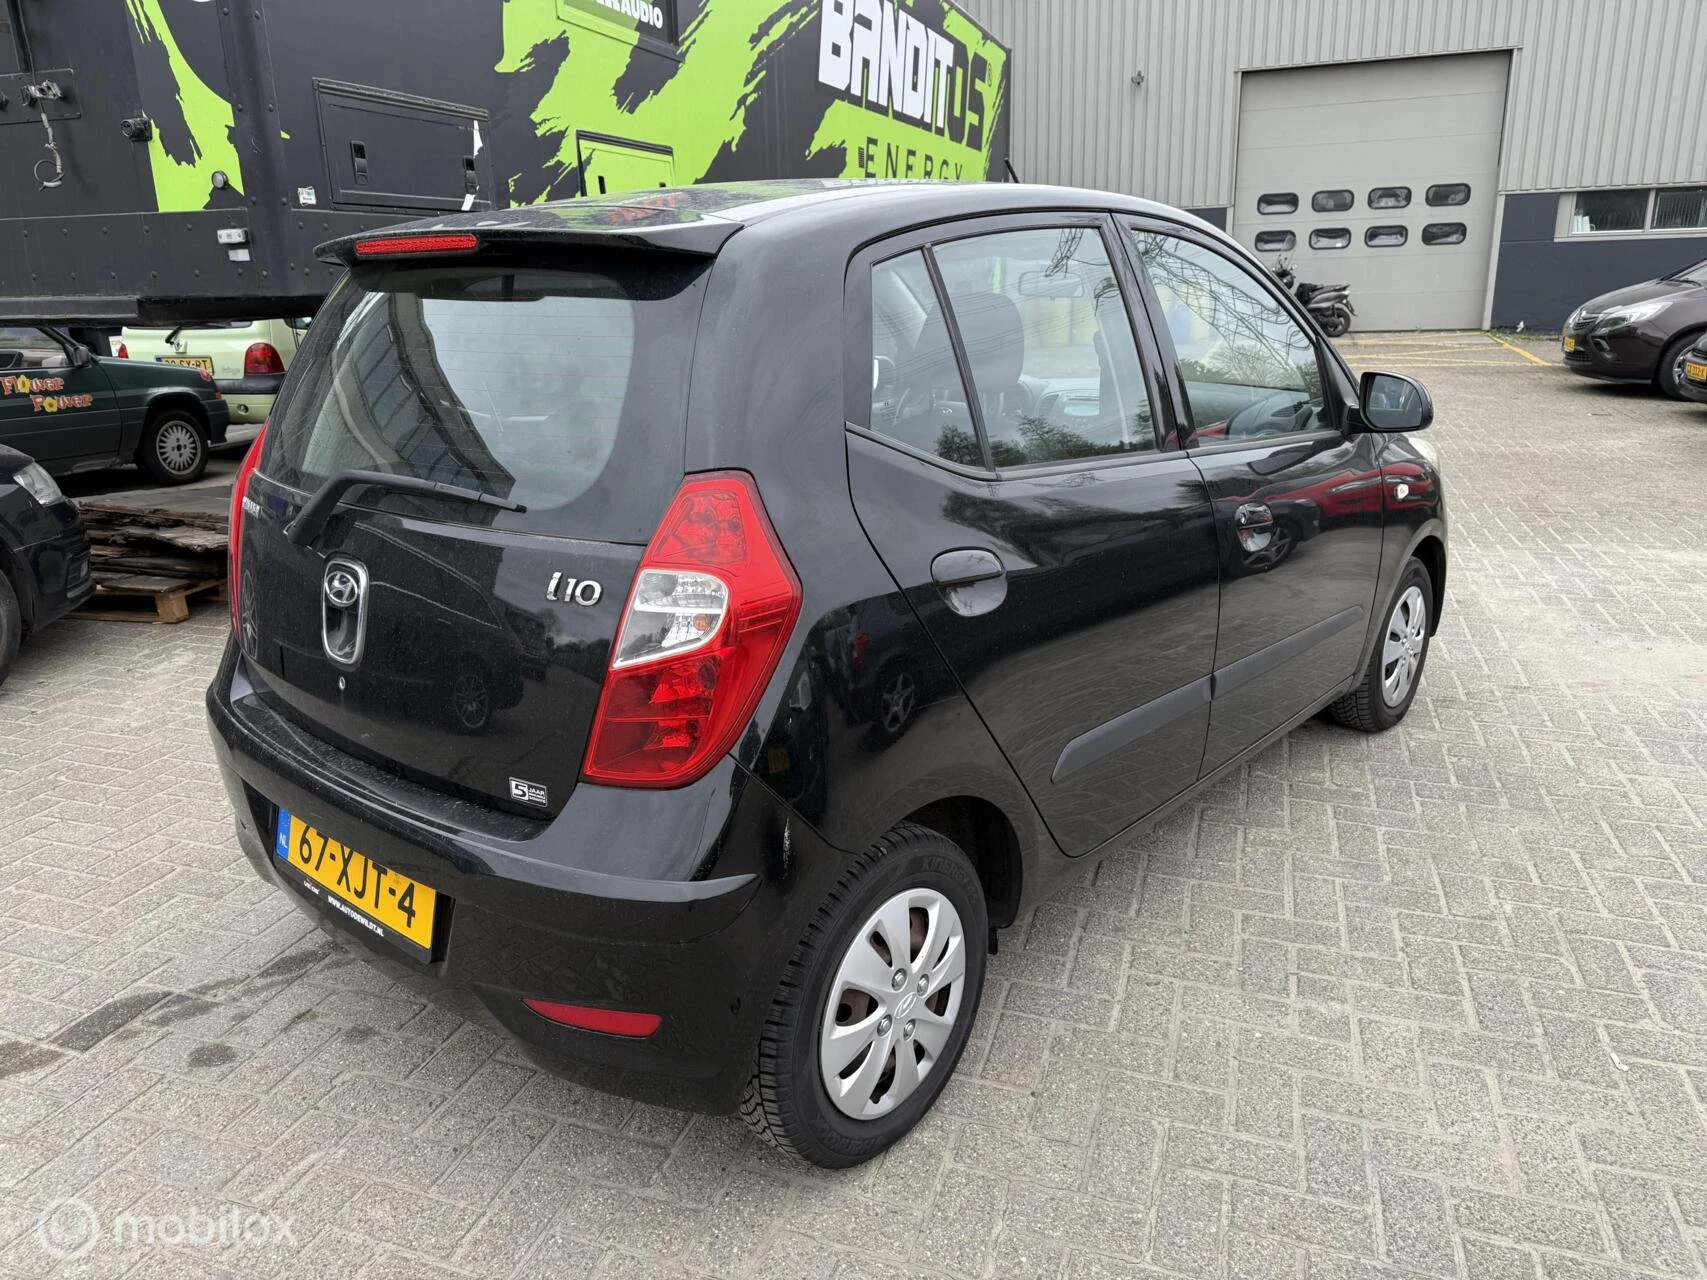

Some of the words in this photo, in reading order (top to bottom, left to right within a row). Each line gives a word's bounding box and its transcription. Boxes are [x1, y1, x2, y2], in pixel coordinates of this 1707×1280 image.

[818, 0, 988, 152] BANDITOS
[513, 783, 527, 798] 5
[279, 832, 288, 849] NL
[299, 825, 416, 929] 67-XJT-4
